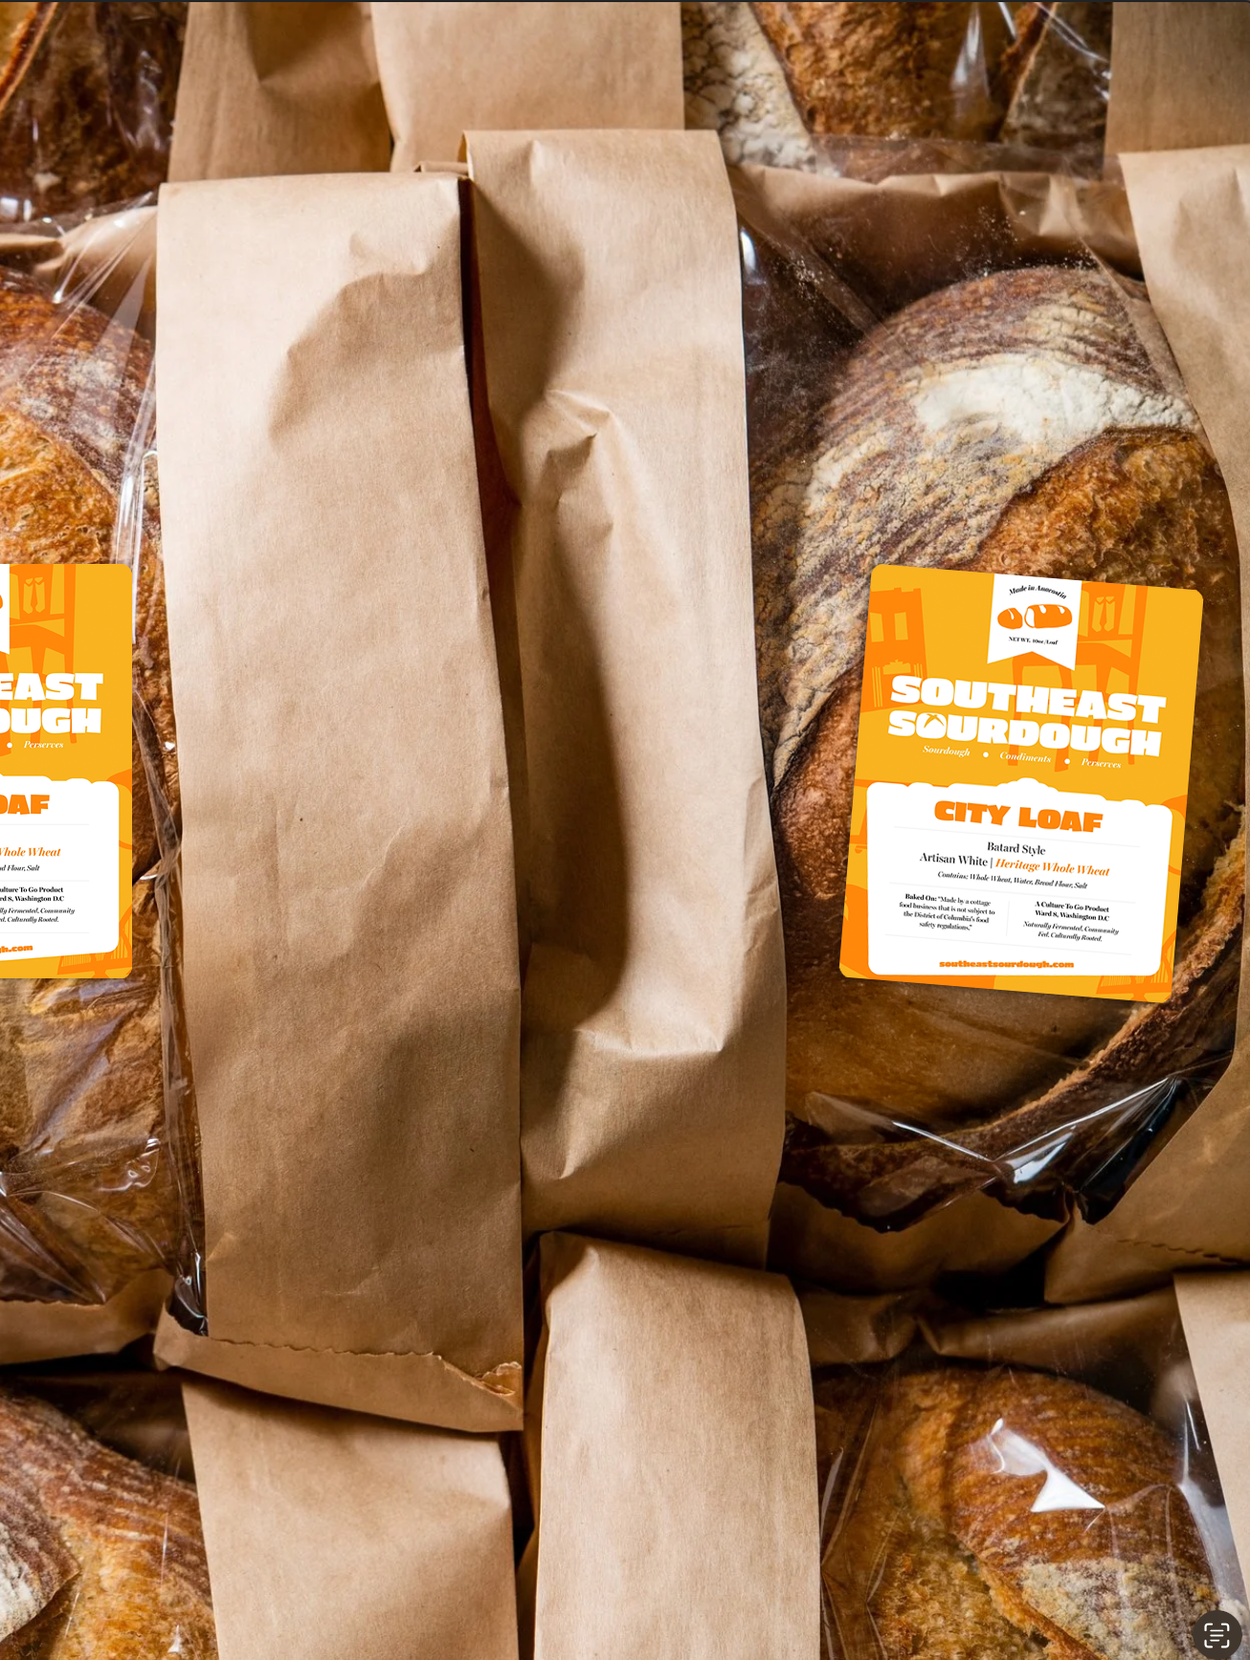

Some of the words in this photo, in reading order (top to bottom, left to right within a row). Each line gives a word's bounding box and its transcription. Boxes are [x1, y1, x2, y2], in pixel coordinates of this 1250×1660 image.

[1009, 585, 1027, 594] Made
[1037, 585, 1066, 599] Anacostia
[890, 675, 1166, 723] SOUTHEAST
[887, 710, 1162, 757] SOURDOUGH
[23, 740, 65, 749] Perserves
[922, 745, 970, 757] Sourdough
[999, 751, 1051, 762] Condiments
[1081, 758, 1121, 768] Perserves
[933, 800, 1011, 826] CITY
[1017, 806, 1103, 832] LOAF
[28, 846, 61, 856] Wheat
[987, 841, 1019, 852] Batard
[1021, 845, 1045, 856] Style
[919, 852, 955, 863] Artisan
[958, 855, 988, 866] White
[995, 858, 1040, 872] Heritage
[1042, 861, 1075, 873] Whole
[1077, 864, 1110, 876] Wheat
[937, 871, 968, 879] Contains:
[990, 875, 1012, 883] Wheat,
[1013, 877, 1033, 885] Water,
[1034, 878, 1058, 886] Bread
[1054, 880, 1073, 888] Flour,
[1059, 911, 1096, 920] Washington
[1024, 920, 1051, 929] Naturally
[1083, 926, 1119, 935] Community
[1050, 932, 1080, 940] Culturally
[938, 959, 1074, 968] southeastsourdough.com
